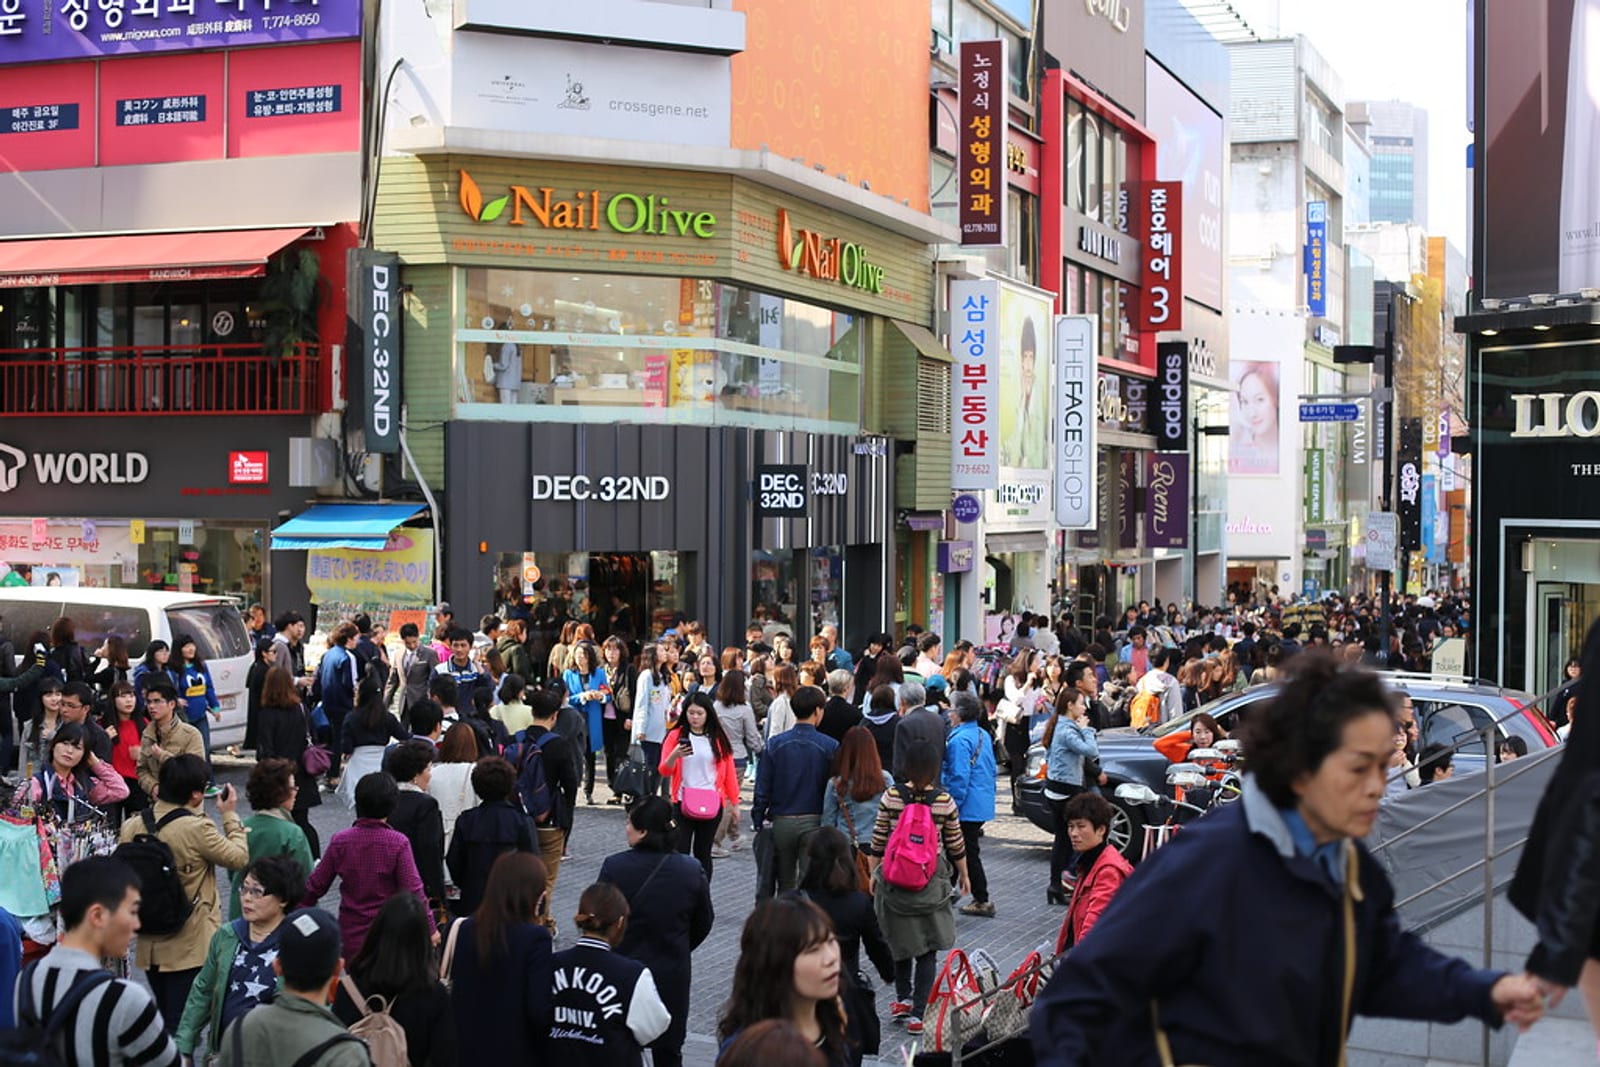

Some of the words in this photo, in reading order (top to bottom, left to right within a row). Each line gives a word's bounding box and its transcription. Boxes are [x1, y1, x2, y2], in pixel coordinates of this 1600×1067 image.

[971, 53, 993, 110] 노정식
[609, 98, 709, 119] crossgene.net
[969, 115, 994, 217] 성형외과
[509, 184, 600, 231] Nail
[606, 192, 718, 239] Olive
[799, 228, 841, 281] Nail
[841, 242, 885, 294] Olive
[1149, 285, 1170, 324] 3
[372, 264, 391, 437] DEC.32ND
[1161, 353, 1182, 439] adidas
[33, 452, 149, 485] WORLD
[760, 474, 805, 492] DEC.
[955, 463, 991, 475] 773-6622
[532, 475, 670, 502] DEC.32ND
[760, 492, 805, 509] 32ND
[552, 966, 623, 1020] NKOOK
[554, 1006, 598, 1029] UNIV.
